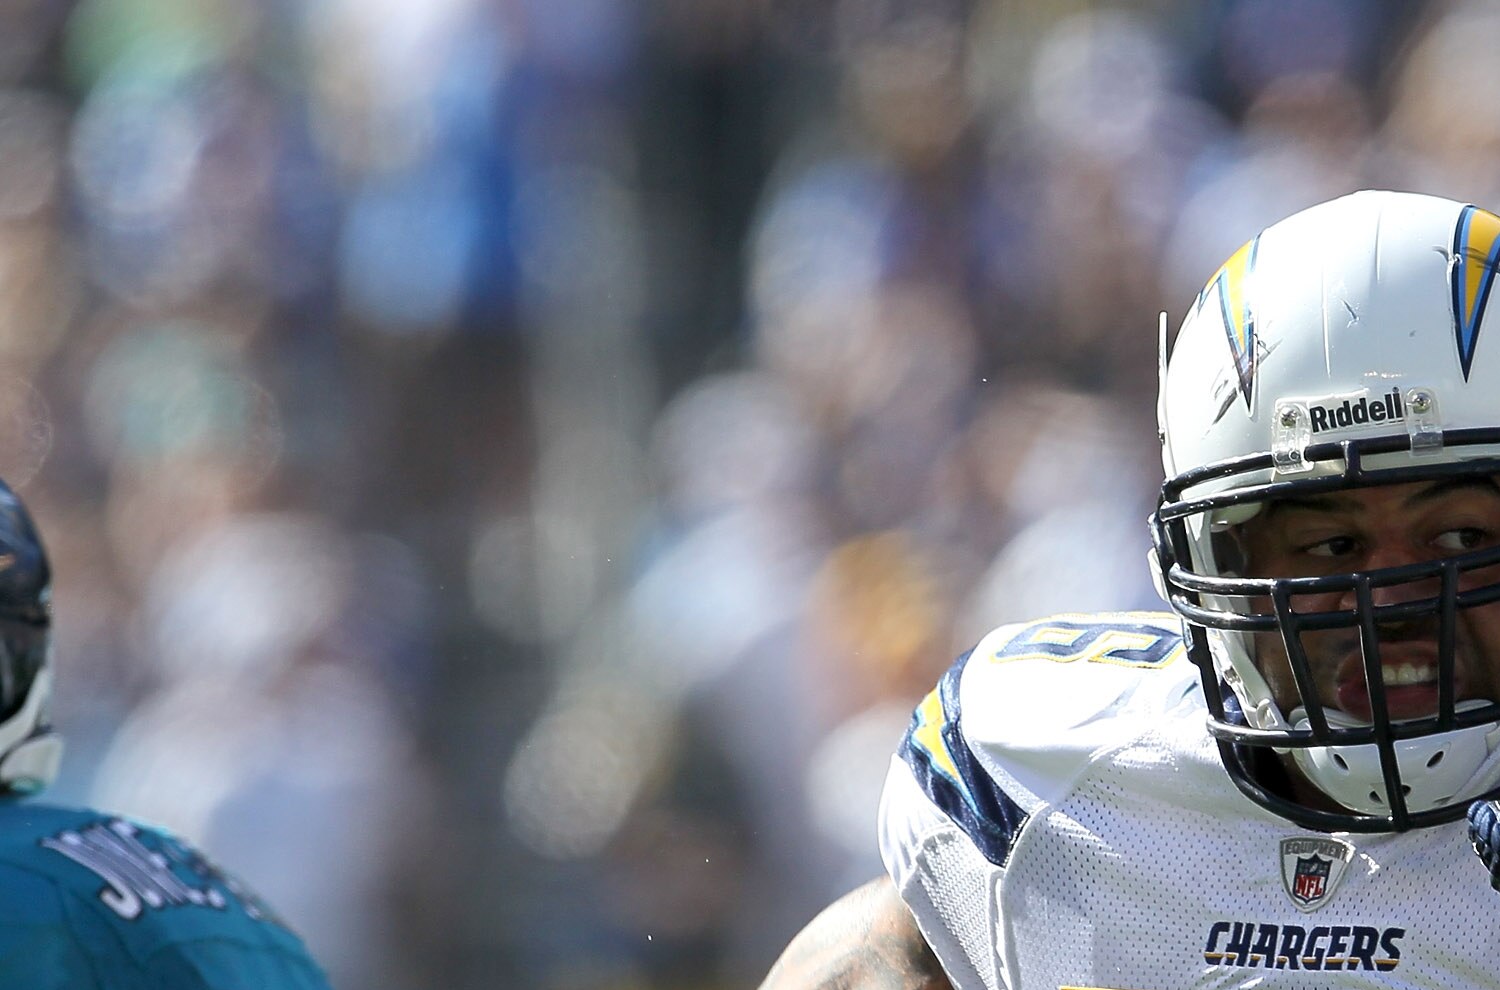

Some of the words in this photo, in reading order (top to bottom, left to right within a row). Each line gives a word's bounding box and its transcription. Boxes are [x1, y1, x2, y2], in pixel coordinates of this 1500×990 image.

[1309, 392, 1403, 433] Riddell
[1294, 874, 1325, 899] NFL
[1204, 921, 1405, 972] CHARGERS
